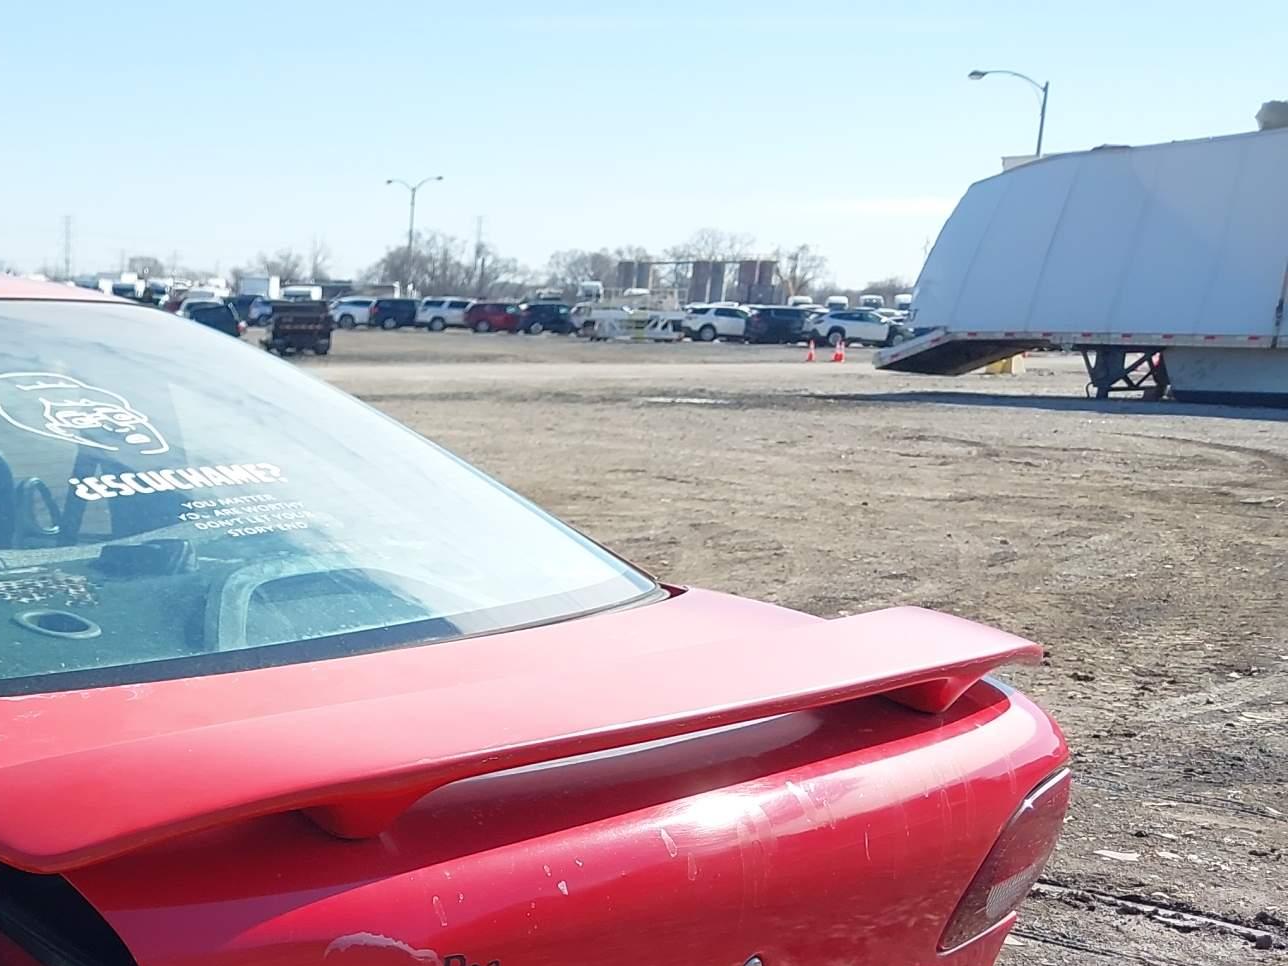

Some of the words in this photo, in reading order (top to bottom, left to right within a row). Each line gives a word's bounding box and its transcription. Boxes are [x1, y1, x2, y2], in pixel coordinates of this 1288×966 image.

[181, 500, 216, 510] YOU
[218, 493, 275, 505] MATTER
[214, 506, 243, 517] ARE
[228, 524, 275, 538] STORY
